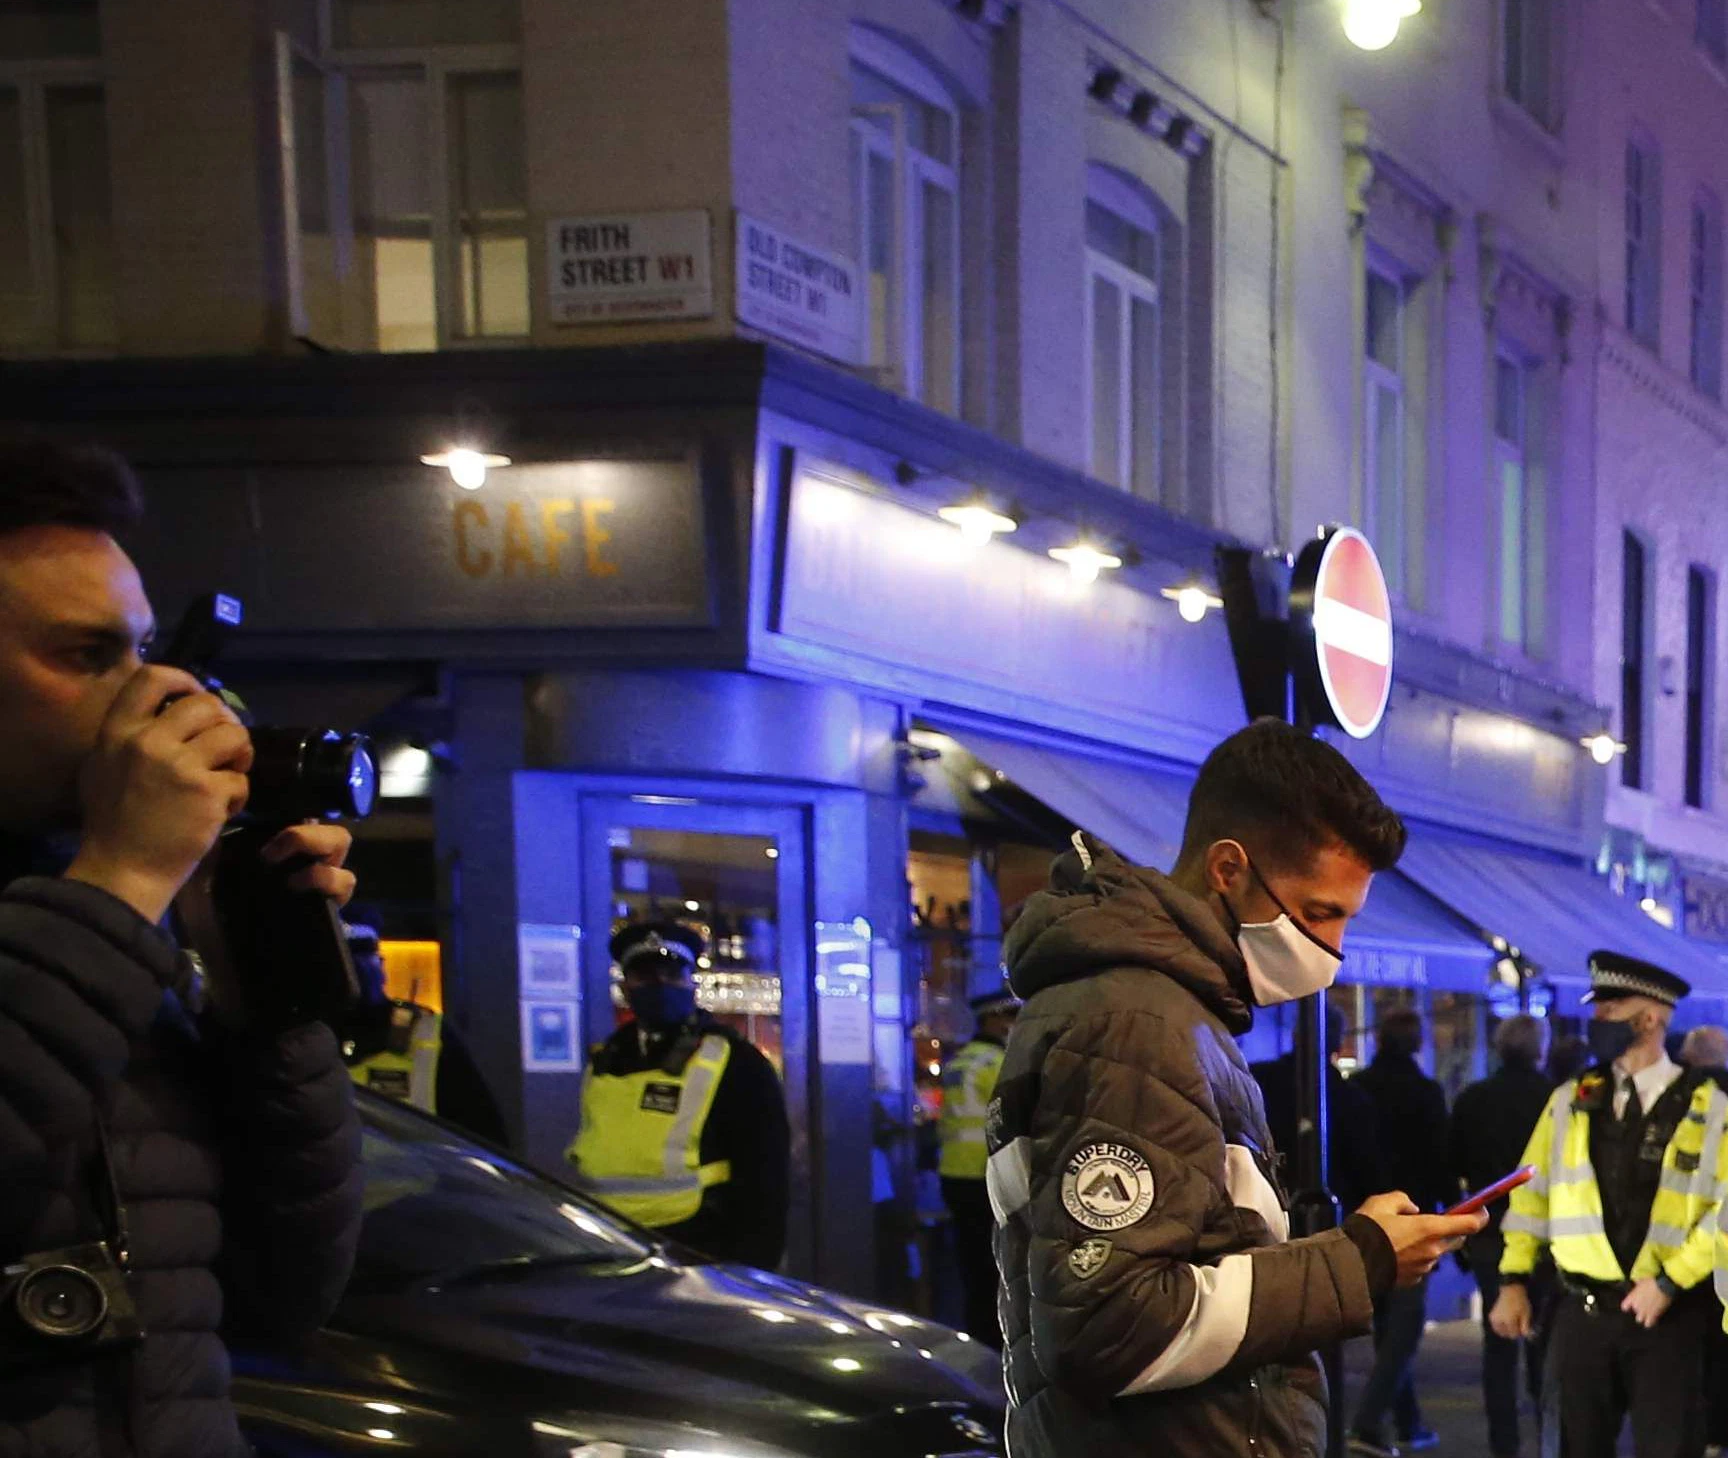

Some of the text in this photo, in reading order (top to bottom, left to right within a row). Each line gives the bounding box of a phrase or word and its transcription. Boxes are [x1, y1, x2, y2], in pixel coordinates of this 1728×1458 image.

[560, 223, 631, 254] FRITH
[560, 253, 695, 288] STREET W1
[452, 498, 621, 579] CAFE
[1065, 1143, 1149, 1176] SUPERDRY
[1064, 1189, 1113, 1228] MOUNTAIN
